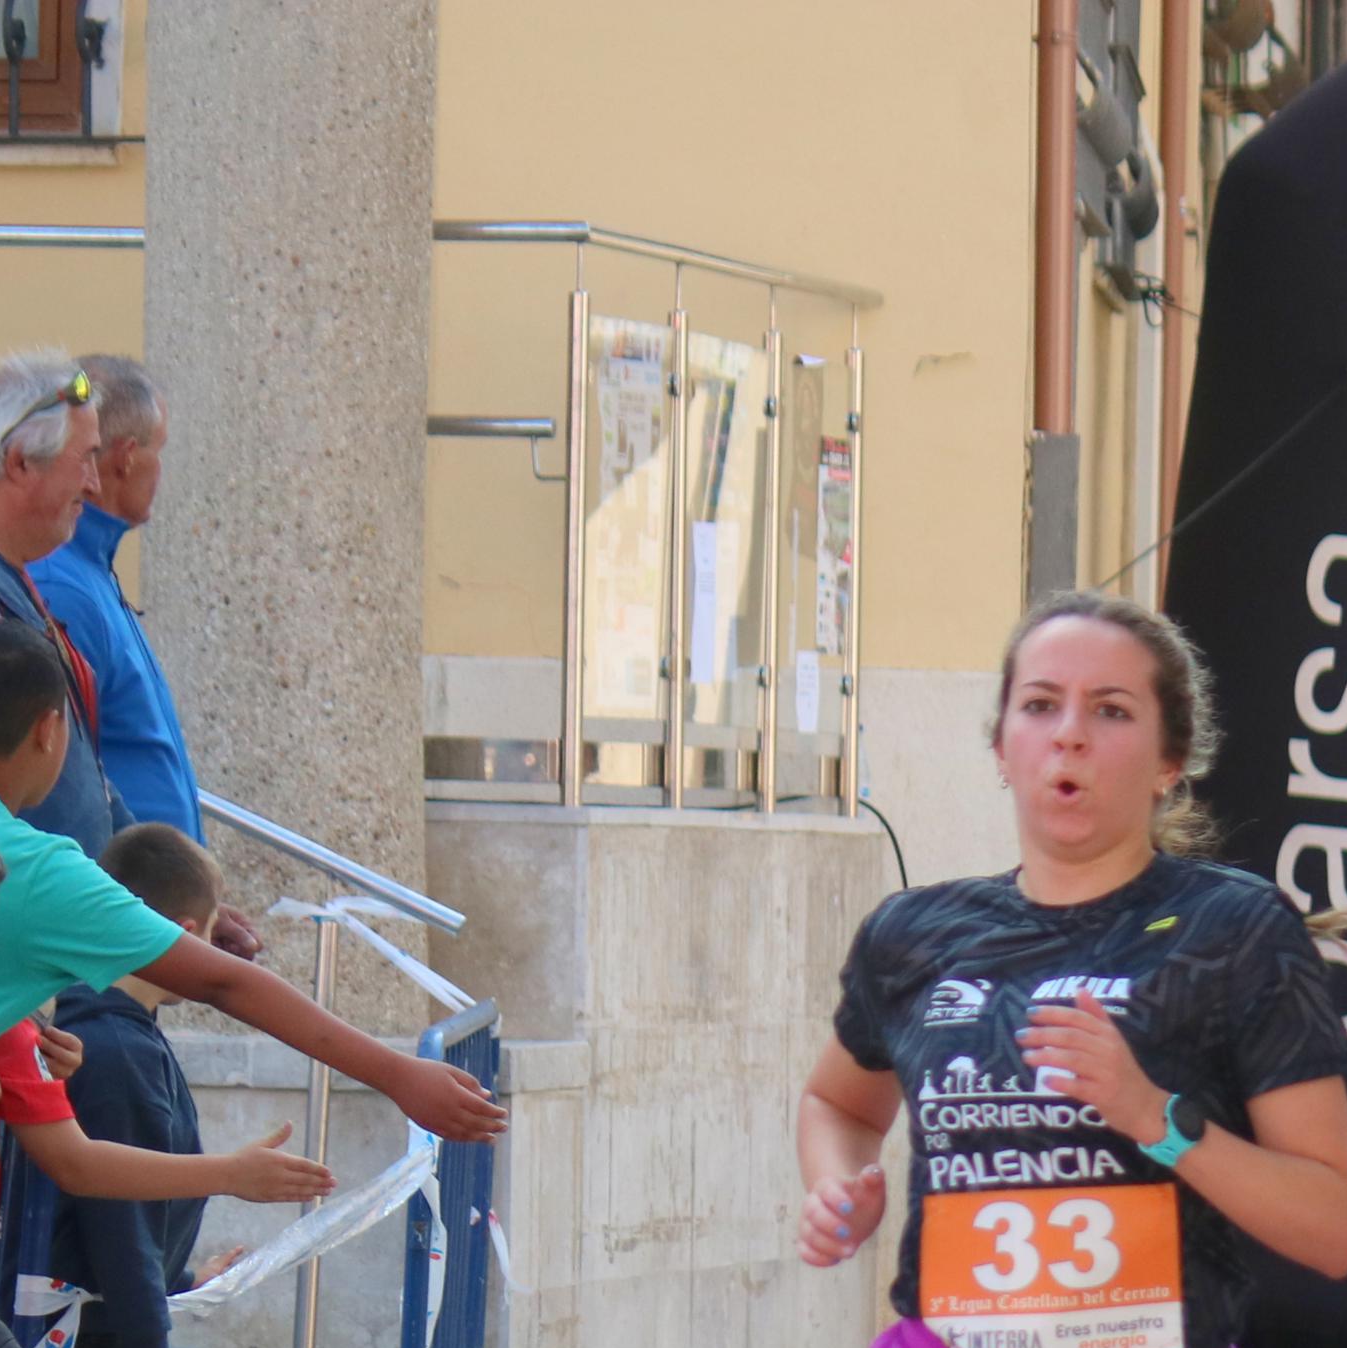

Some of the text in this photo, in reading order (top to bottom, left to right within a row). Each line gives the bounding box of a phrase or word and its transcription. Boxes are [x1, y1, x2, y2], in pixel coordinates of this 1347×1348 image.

[919, 1103, 1107, 1132] CORRIENDO
[925, 1131, 951, 1151] POR
[929, 1146, 1125, 1190] PALENCIA
[971, 1198, 1121, 1293] 33
[1055, 1324, 1092, 1338] Eres
[1096, 1316, 1164, 1334] nuestra
